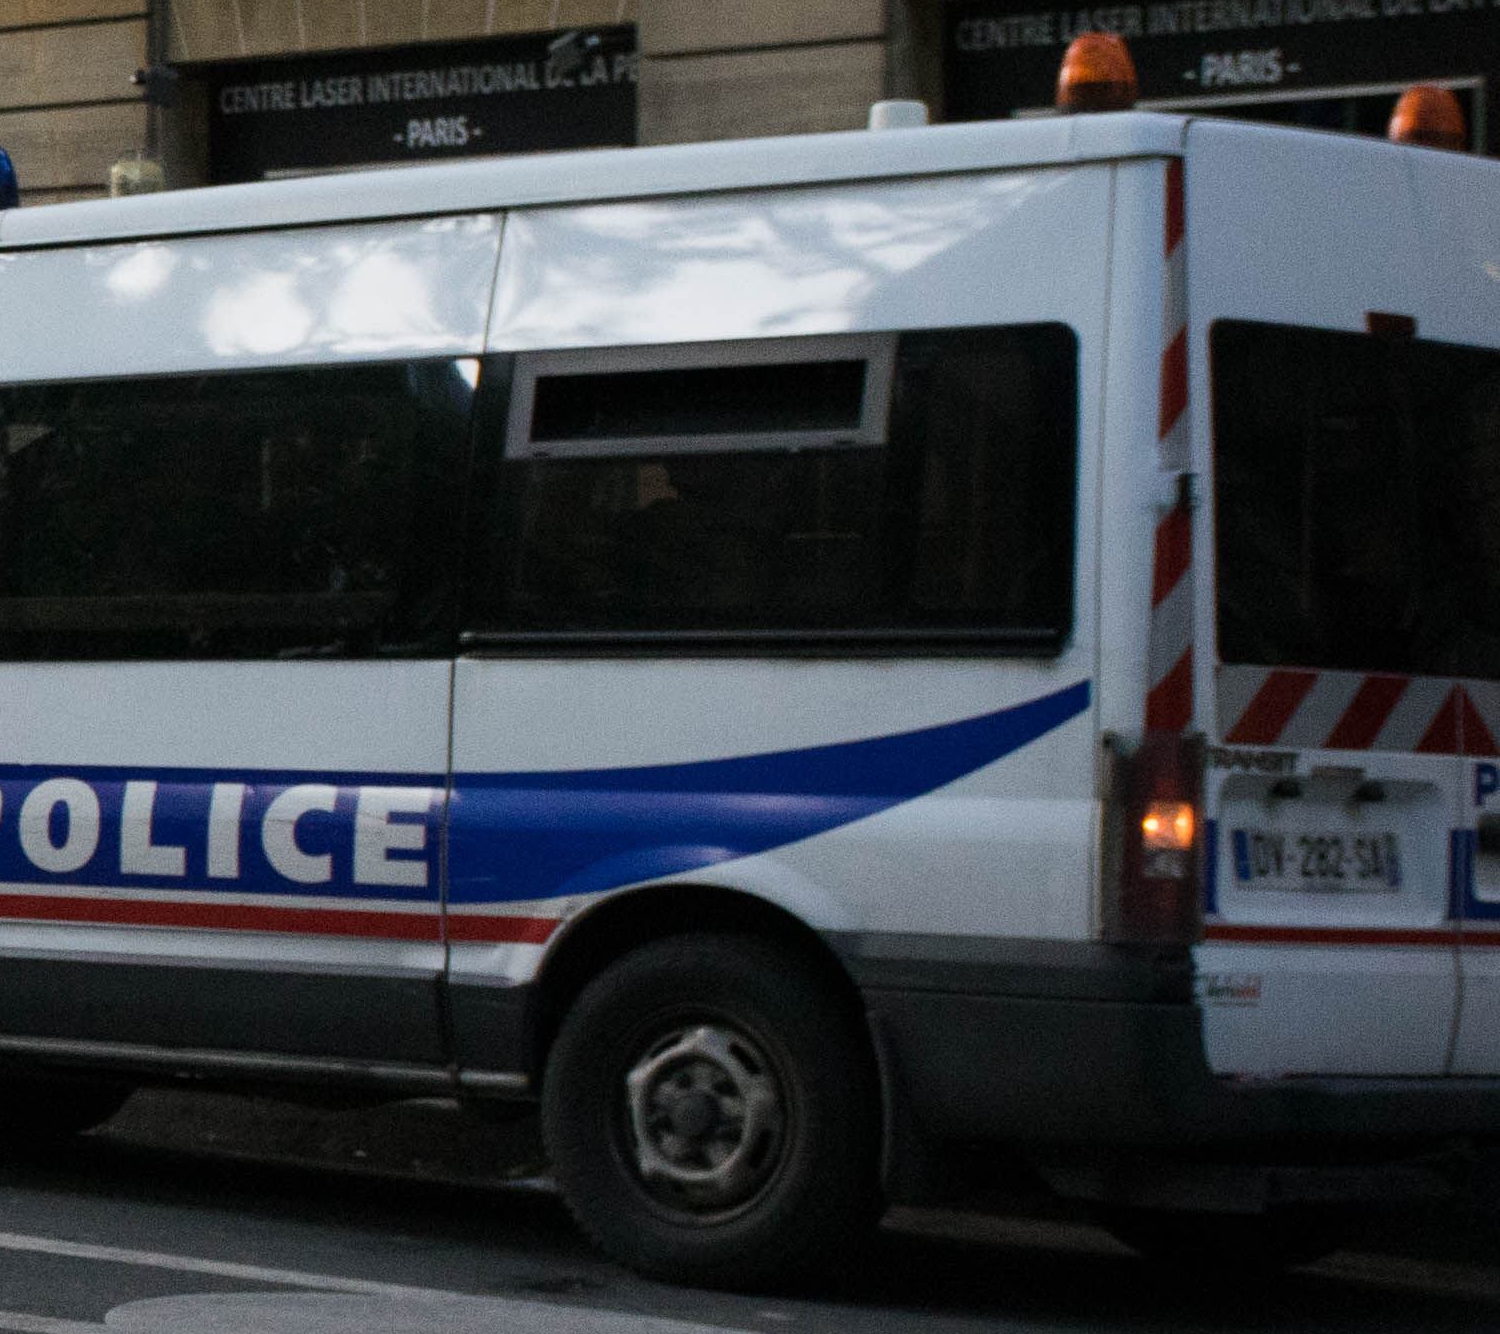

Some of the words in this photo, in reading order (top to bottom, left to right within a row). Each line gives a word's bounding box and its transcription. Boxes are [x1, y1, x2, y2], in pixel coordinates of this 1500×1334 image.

[955, 16, 1054, 51] CENTRE
[220, 82, 296, 115] CENTRE
[301, 76, 364, 108] LASER
[368, 67, 539, 104] INTERNATIONAL
